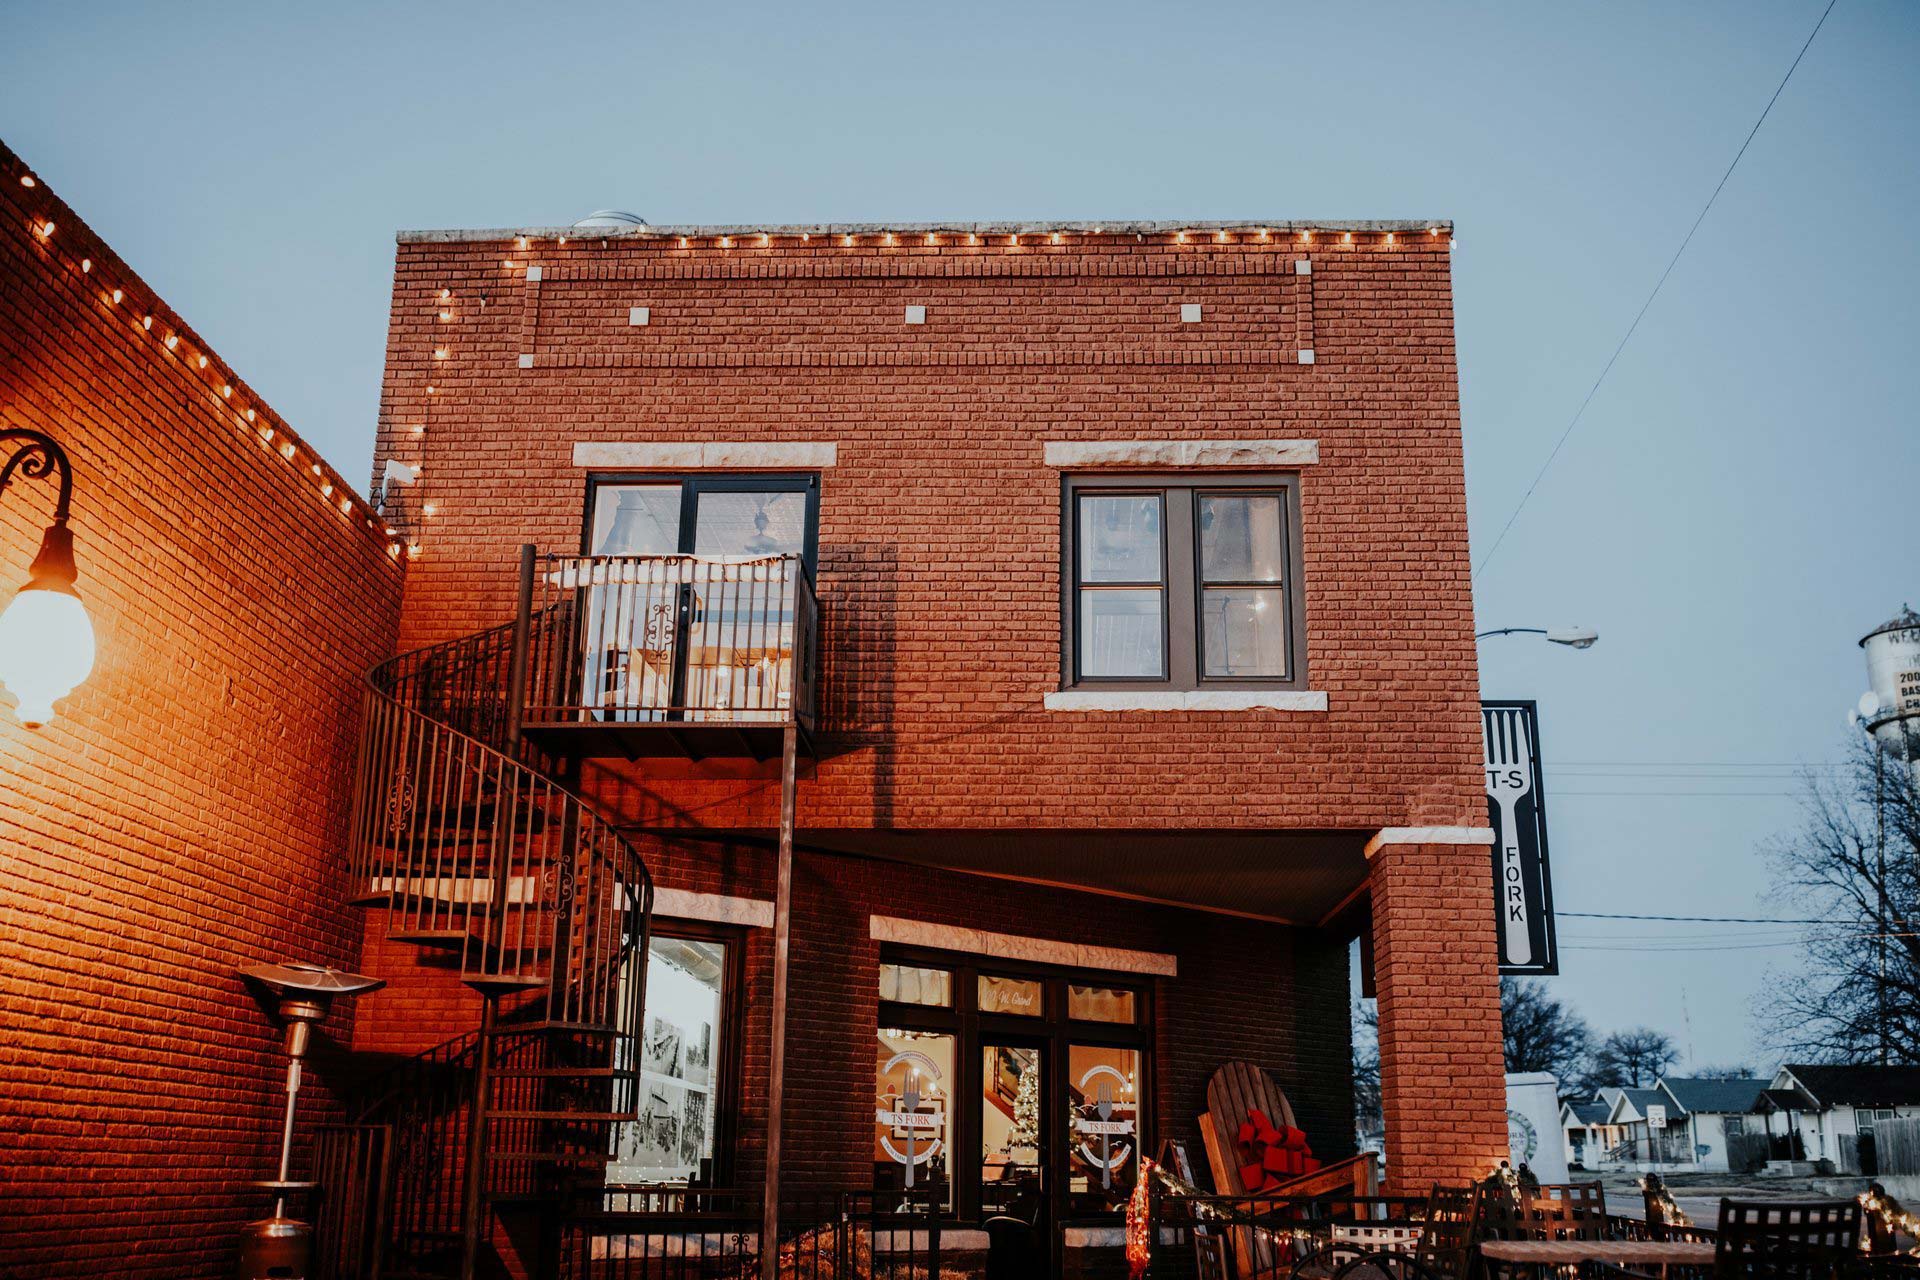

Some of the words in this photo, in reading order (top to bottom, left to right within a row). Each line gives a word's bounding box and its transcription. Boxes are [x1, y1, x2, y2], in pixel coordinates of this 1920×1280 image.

[1505, 847, 1524, 922] FORK
[891, 1114, 903, 1124] TS
[905, 1114, 930, 1125] FORK
[1650, 1117, 1665, 1126] 25
[1100, 1122, 1122, 1133] FORK
